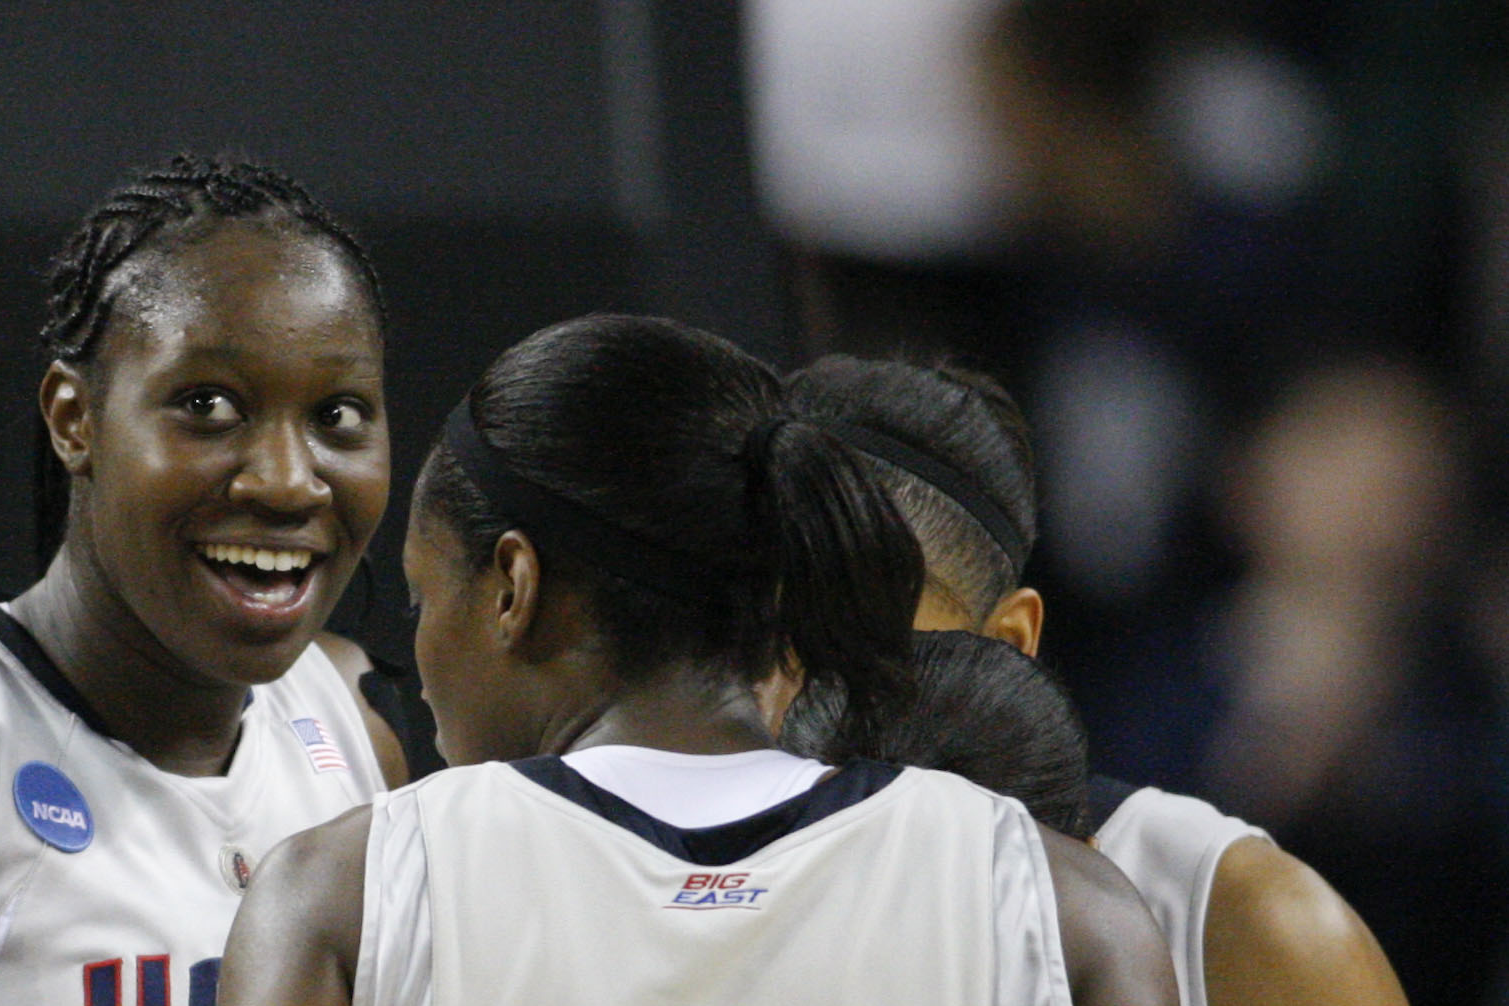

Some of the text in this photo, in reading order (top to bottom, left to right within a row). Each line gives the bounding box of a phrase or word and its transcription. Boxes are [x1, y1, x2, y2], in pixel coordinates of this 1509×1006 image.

[32, 801, 87, 830] NCAA
[682, 873, 751, 890] BIG
[671, 888, 769, 905] EAST
